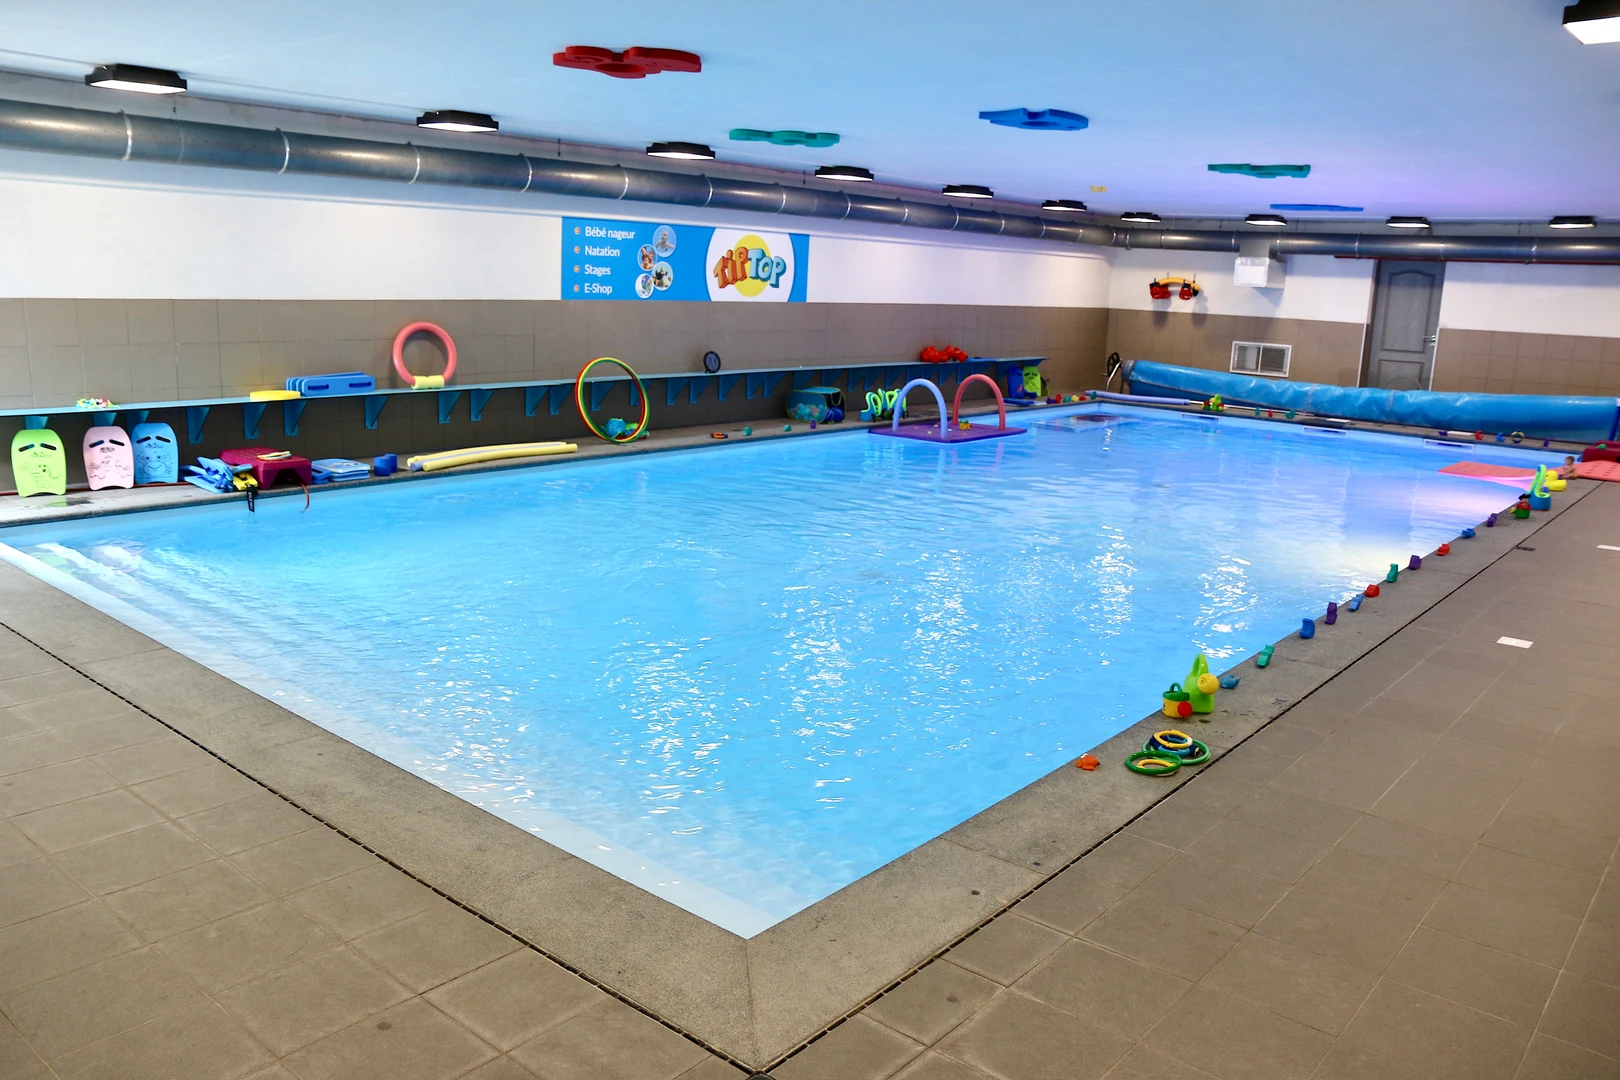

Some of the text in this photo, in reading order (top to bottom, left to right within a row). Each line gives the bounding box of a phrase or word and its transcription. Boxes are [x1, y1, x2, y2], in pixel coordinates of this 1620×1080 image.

[585, 226, 635, 240] Bébé nageur
[584, 245, 620, 257] Natation
[584, 264, 611, 277] Stages
[584, 283, 613, 295] E-Shop
